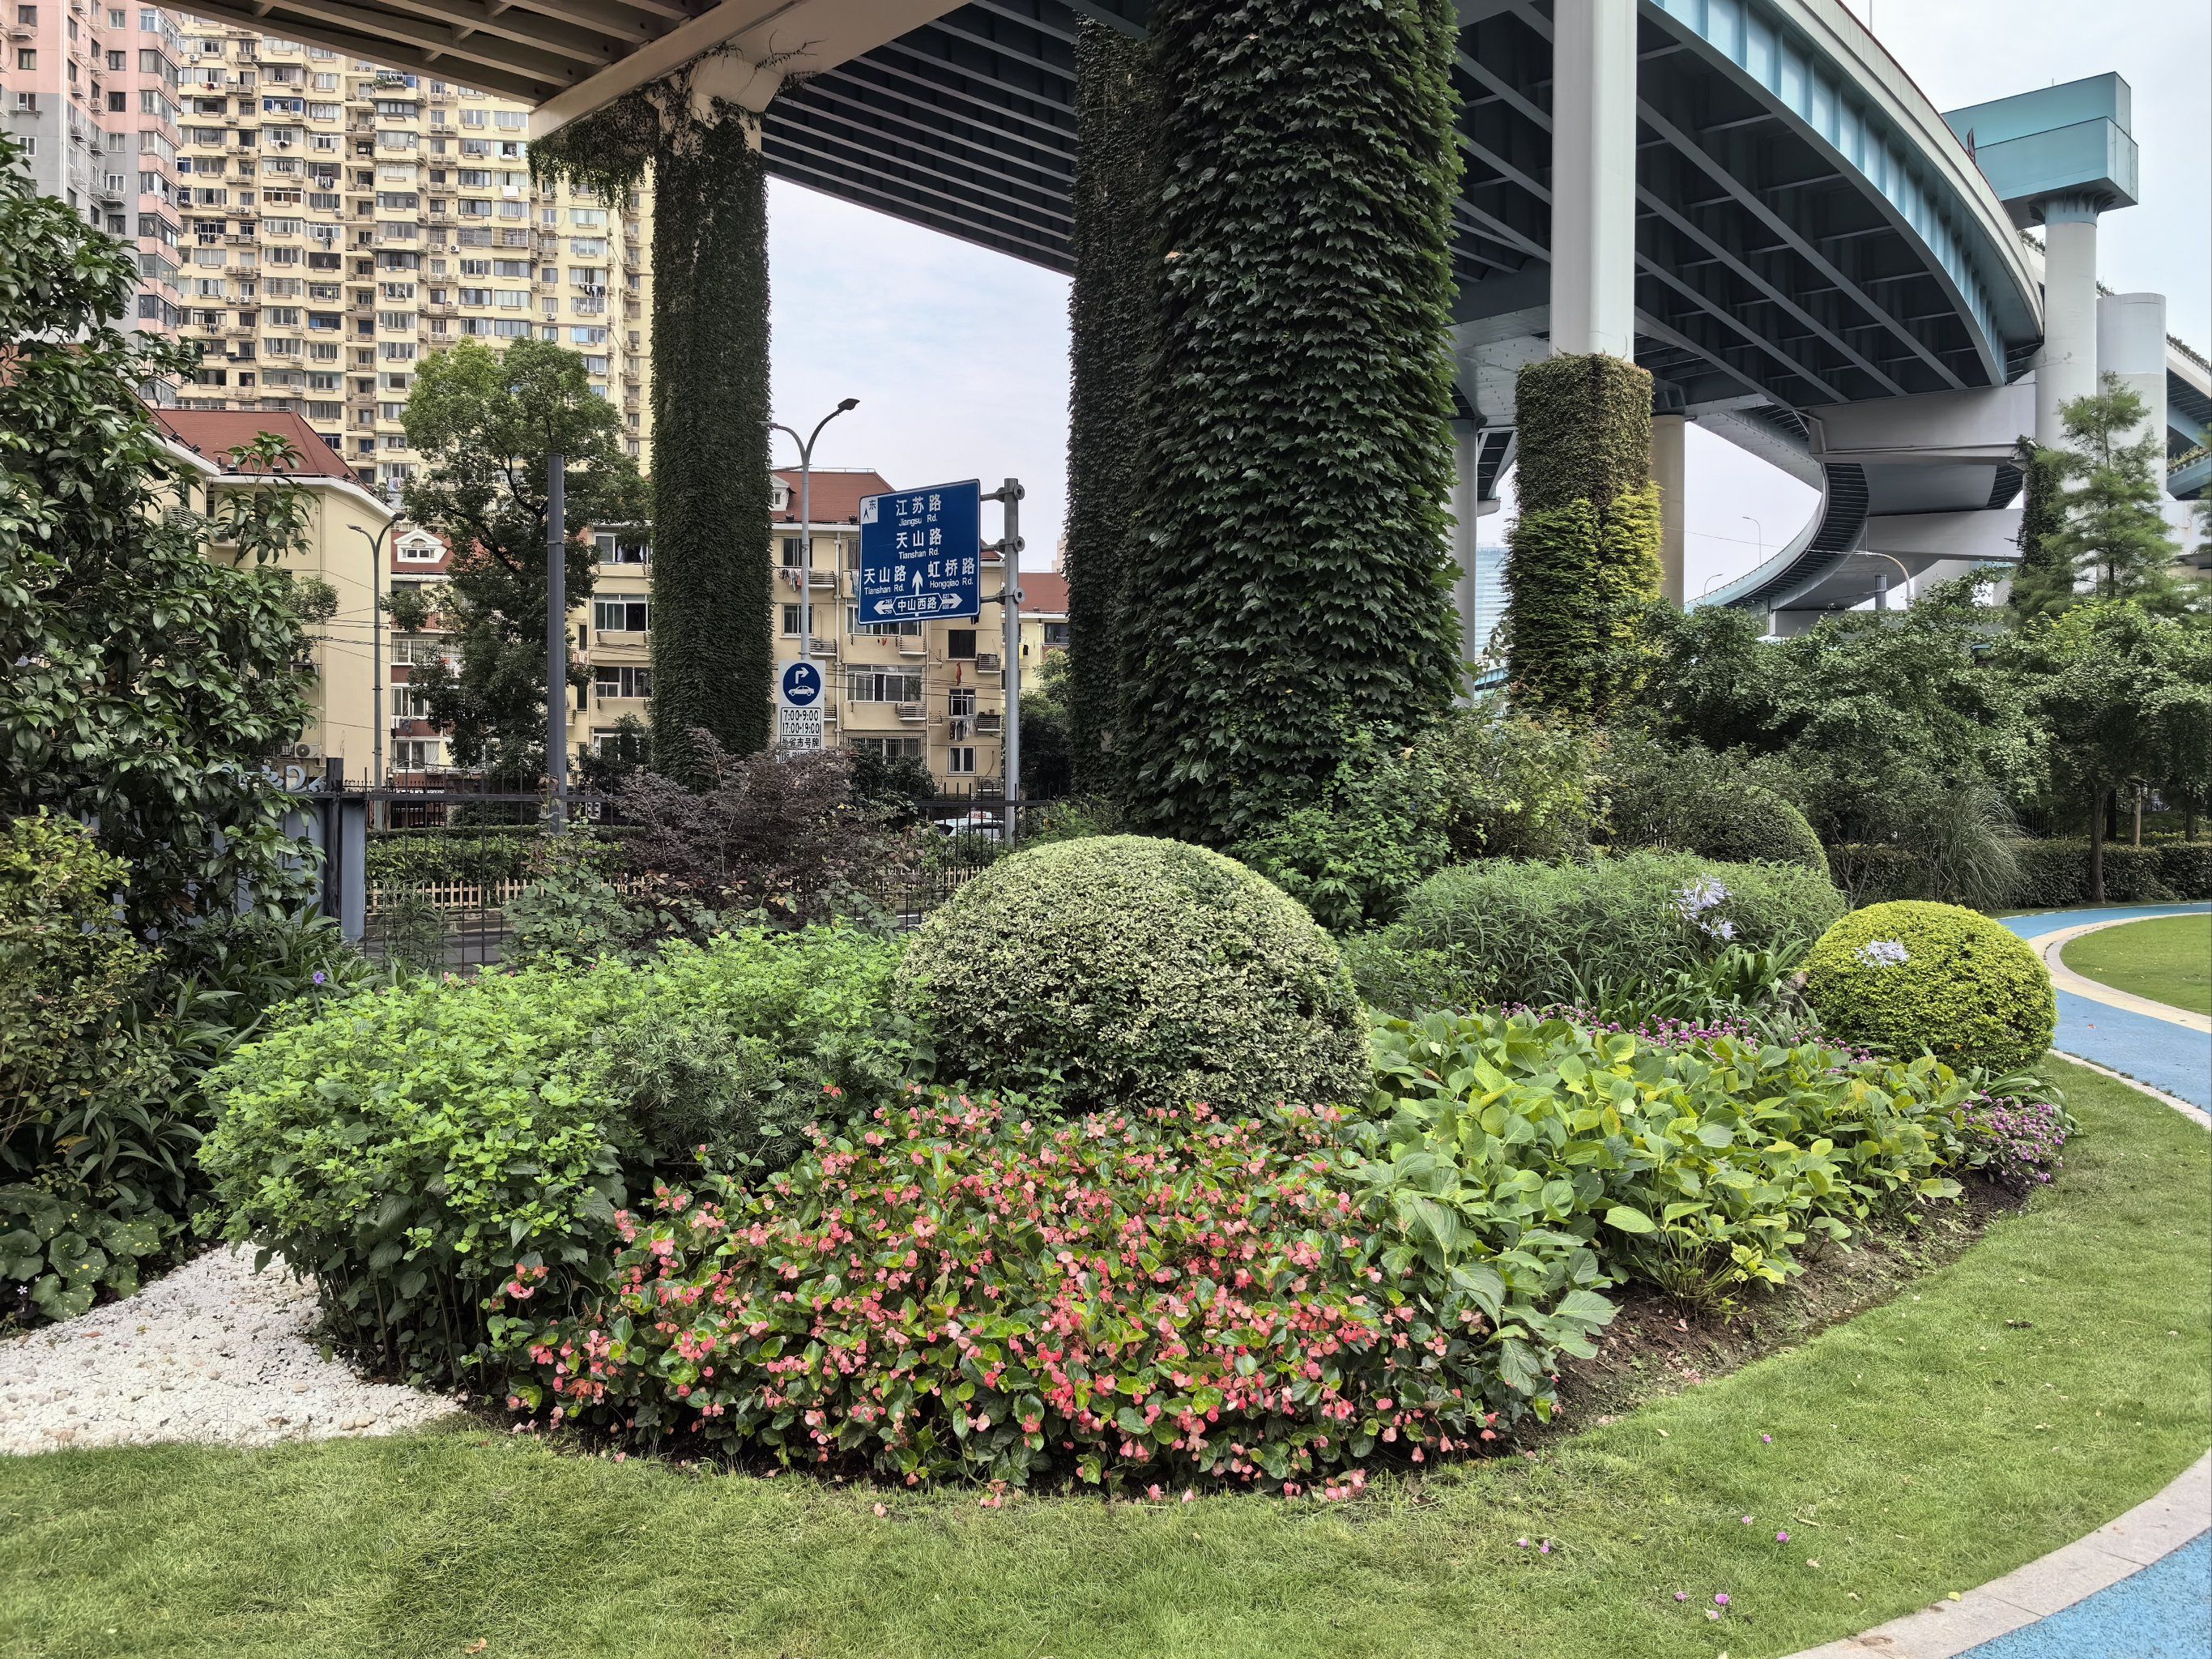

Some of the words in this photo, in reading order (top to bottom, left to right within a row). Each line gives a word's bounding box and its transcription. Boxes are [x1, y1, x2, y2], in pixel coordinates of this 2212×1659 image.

[868, 499, 876, 510] 东
[896, 493, 942, 517] 江苏路
[898, 517, 923, 527] Jiangsu
[927, 514, 938, 523] Rd.
[896, 527, 942, 549] 天山路
[898, 549, 927, 560] Tianshan
[928, 547, 940, 557] Rd.
[927, 557, 975, 578] 虹桥路
[863, 565, 906, 585] 天山路
[864, 585, 891, 595] Tianshan
[893, 583, 905, 592] Rd.
[930, 578, 960, 590] Hongqiao
[961, 577, 974, 586] Rd.
[897, 596, 937, 612] 中山西路
[783, 710, 819, 721] 7:00-9:00
[782, 722, 820, 734] 17:00-19:00
